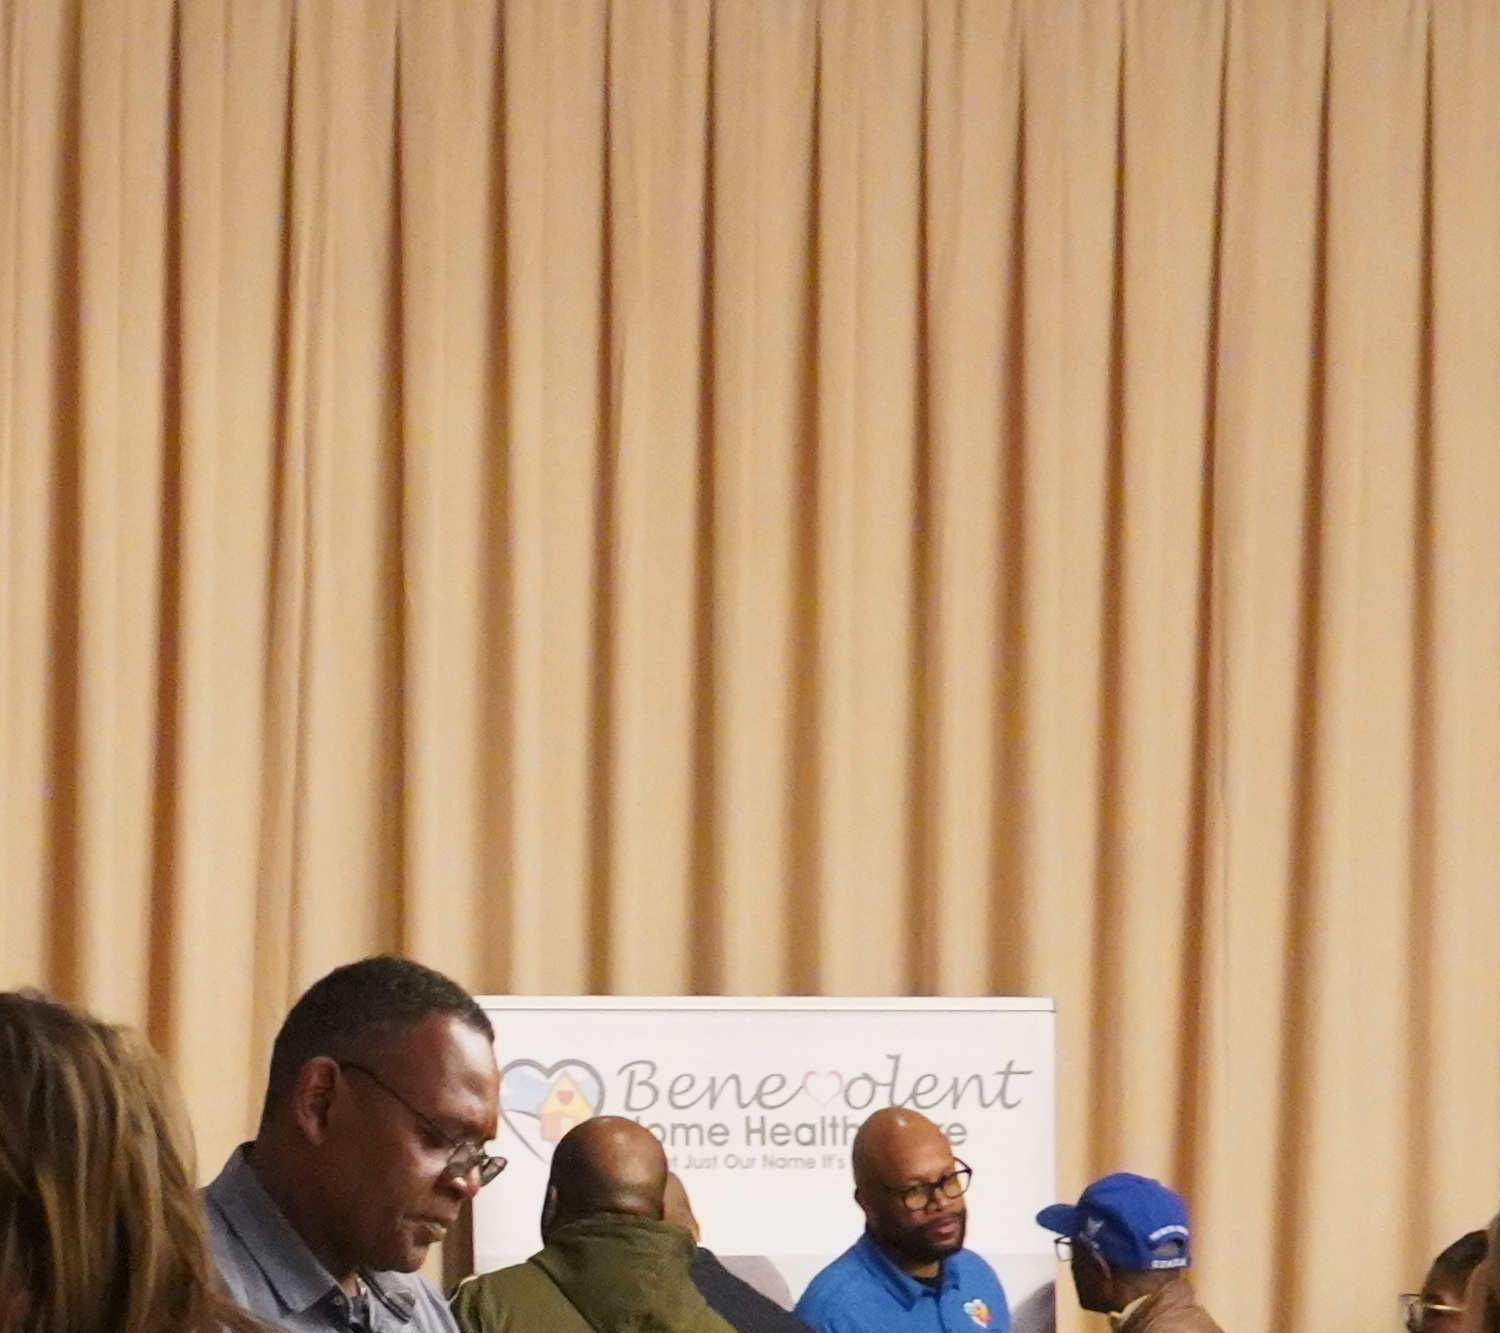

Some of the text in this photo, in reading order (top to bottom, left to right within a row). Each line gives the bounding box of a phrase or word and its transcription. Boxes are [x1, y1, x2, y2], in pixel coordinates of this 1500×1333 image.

[635, 1115, 730, 1147] ome
[684, 1153, 718, 1170] Just
[725, 1153, 756, 1170] Our
[762, 1153, 816, 1170] Name
